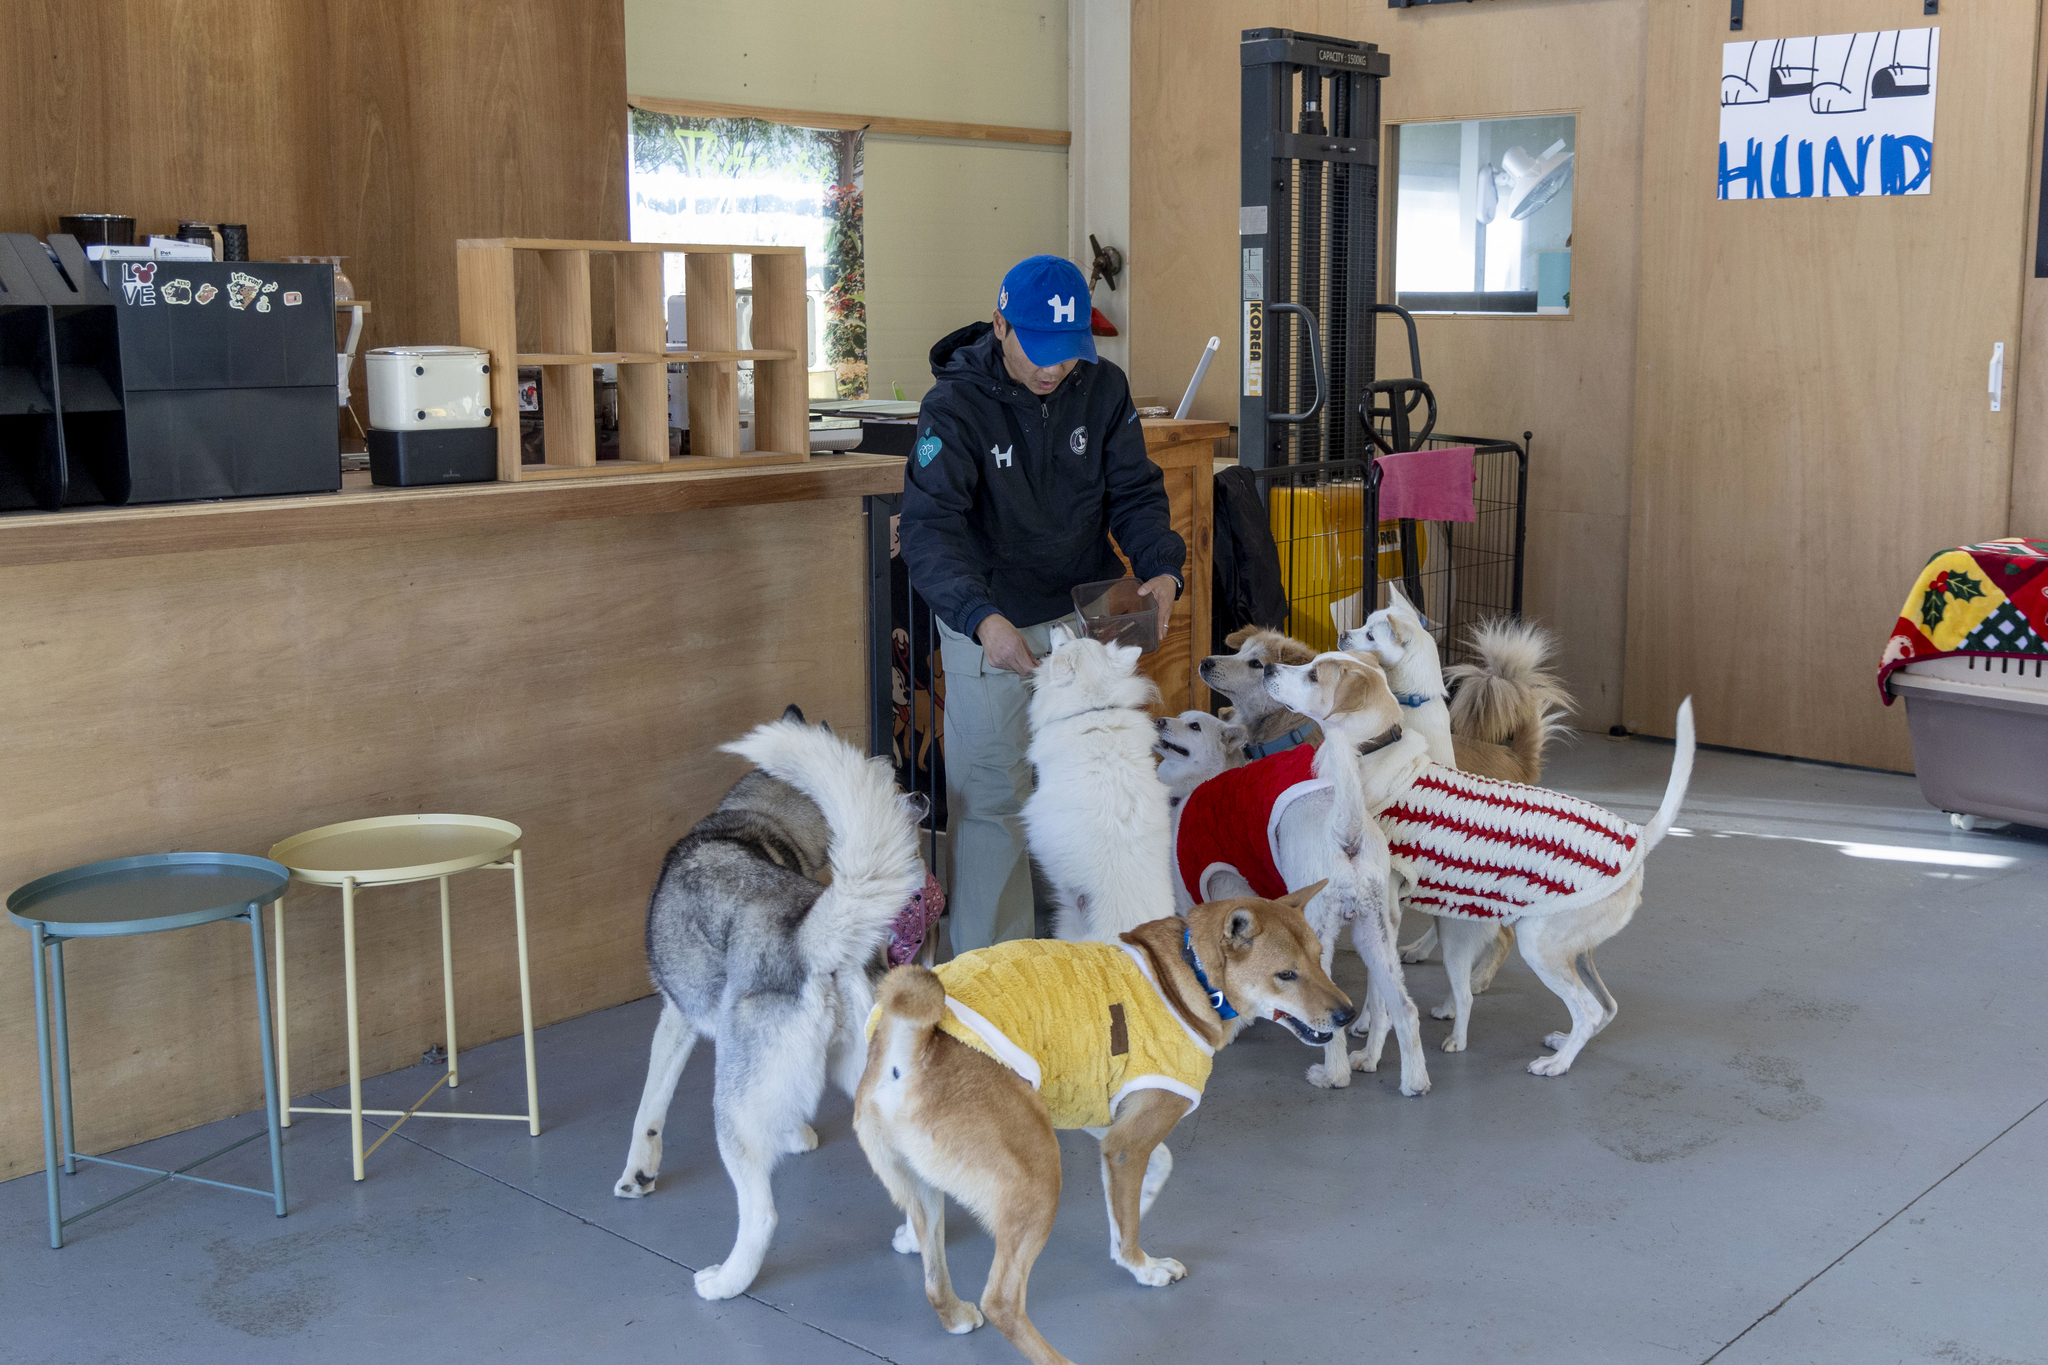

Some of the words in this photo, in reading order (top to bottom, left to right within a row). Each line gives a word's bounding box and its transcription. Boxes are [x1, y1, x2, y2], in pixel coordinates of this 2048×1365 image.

[1319, 50, 1344, 62] CAPACITY
[1347, 54, 1366, 66] 1500KG
[1717, 133, 1932, 200] HUND
[233, 272, 246, 282] Let's
[247, 276, 261, 287] run!
